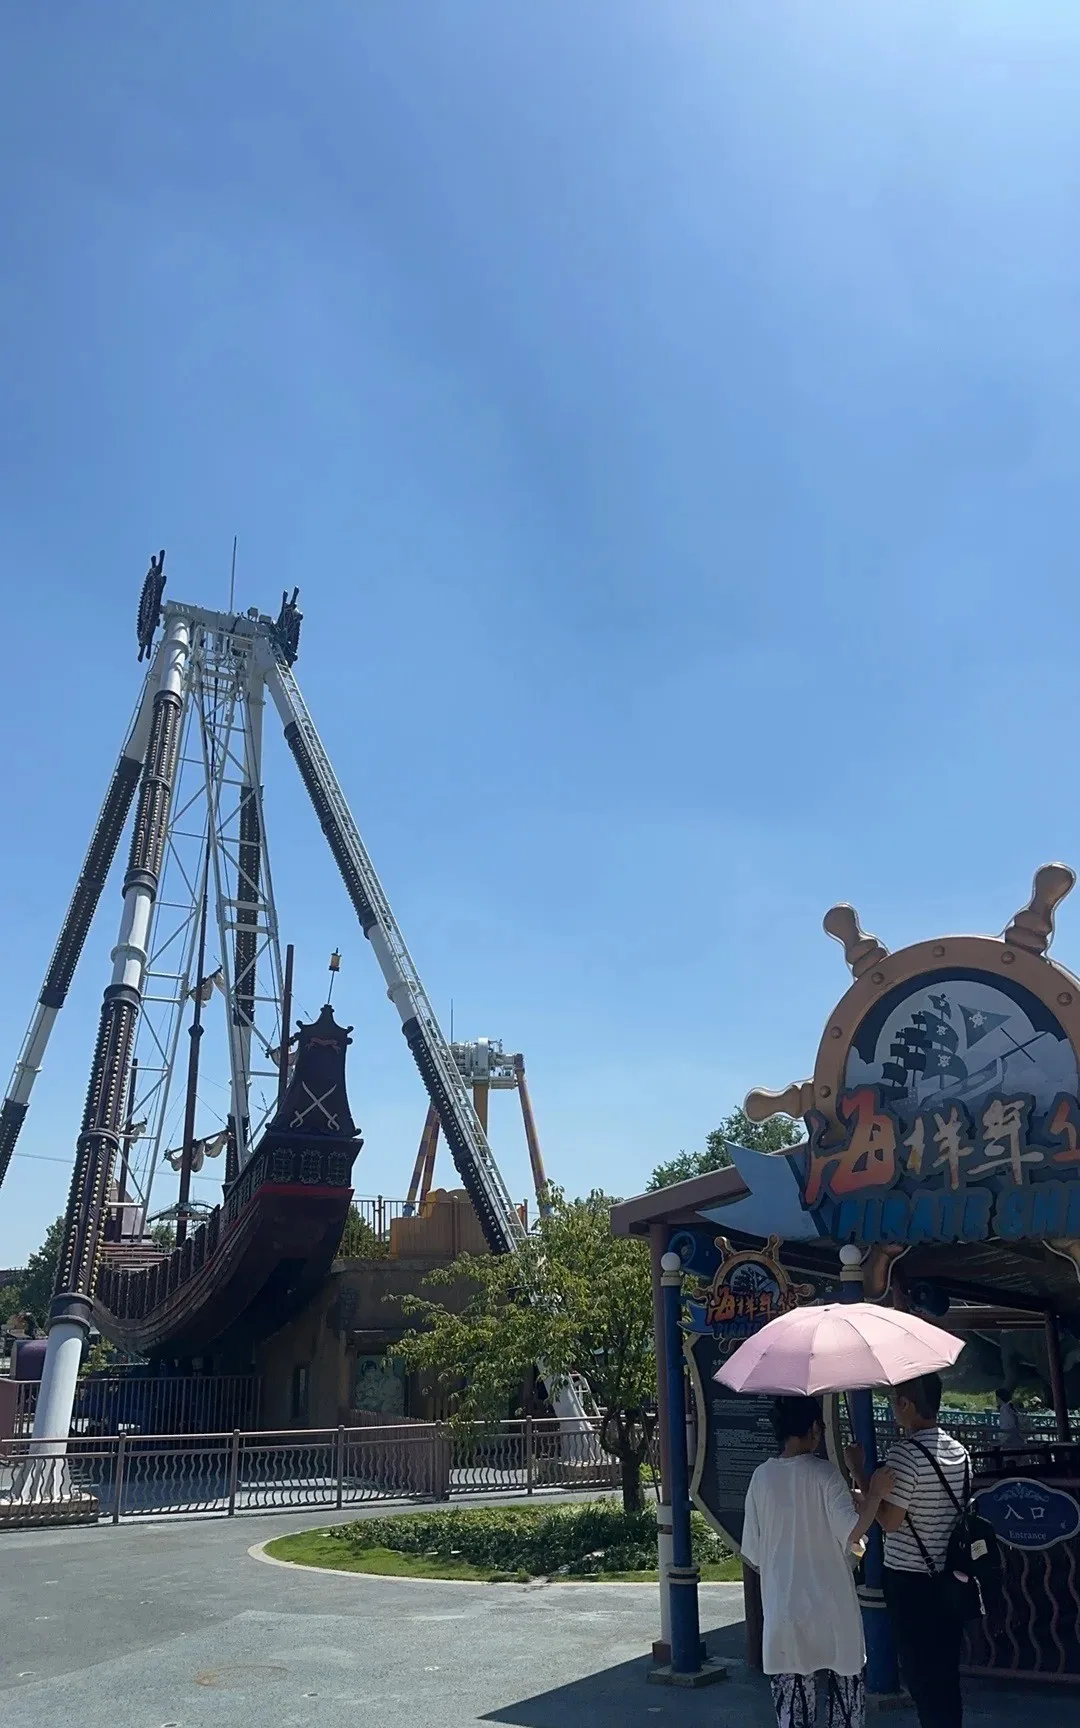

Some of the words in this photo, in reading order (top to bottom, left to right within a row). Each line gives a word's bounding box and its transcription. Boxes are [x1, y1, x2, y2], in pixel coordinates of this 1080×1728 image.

[838, 1195, 988, 1241] PIRATE
[1004, 1504, 1046, 1520] 入口
[1009, 1530, 1047, 1540] Entrance
